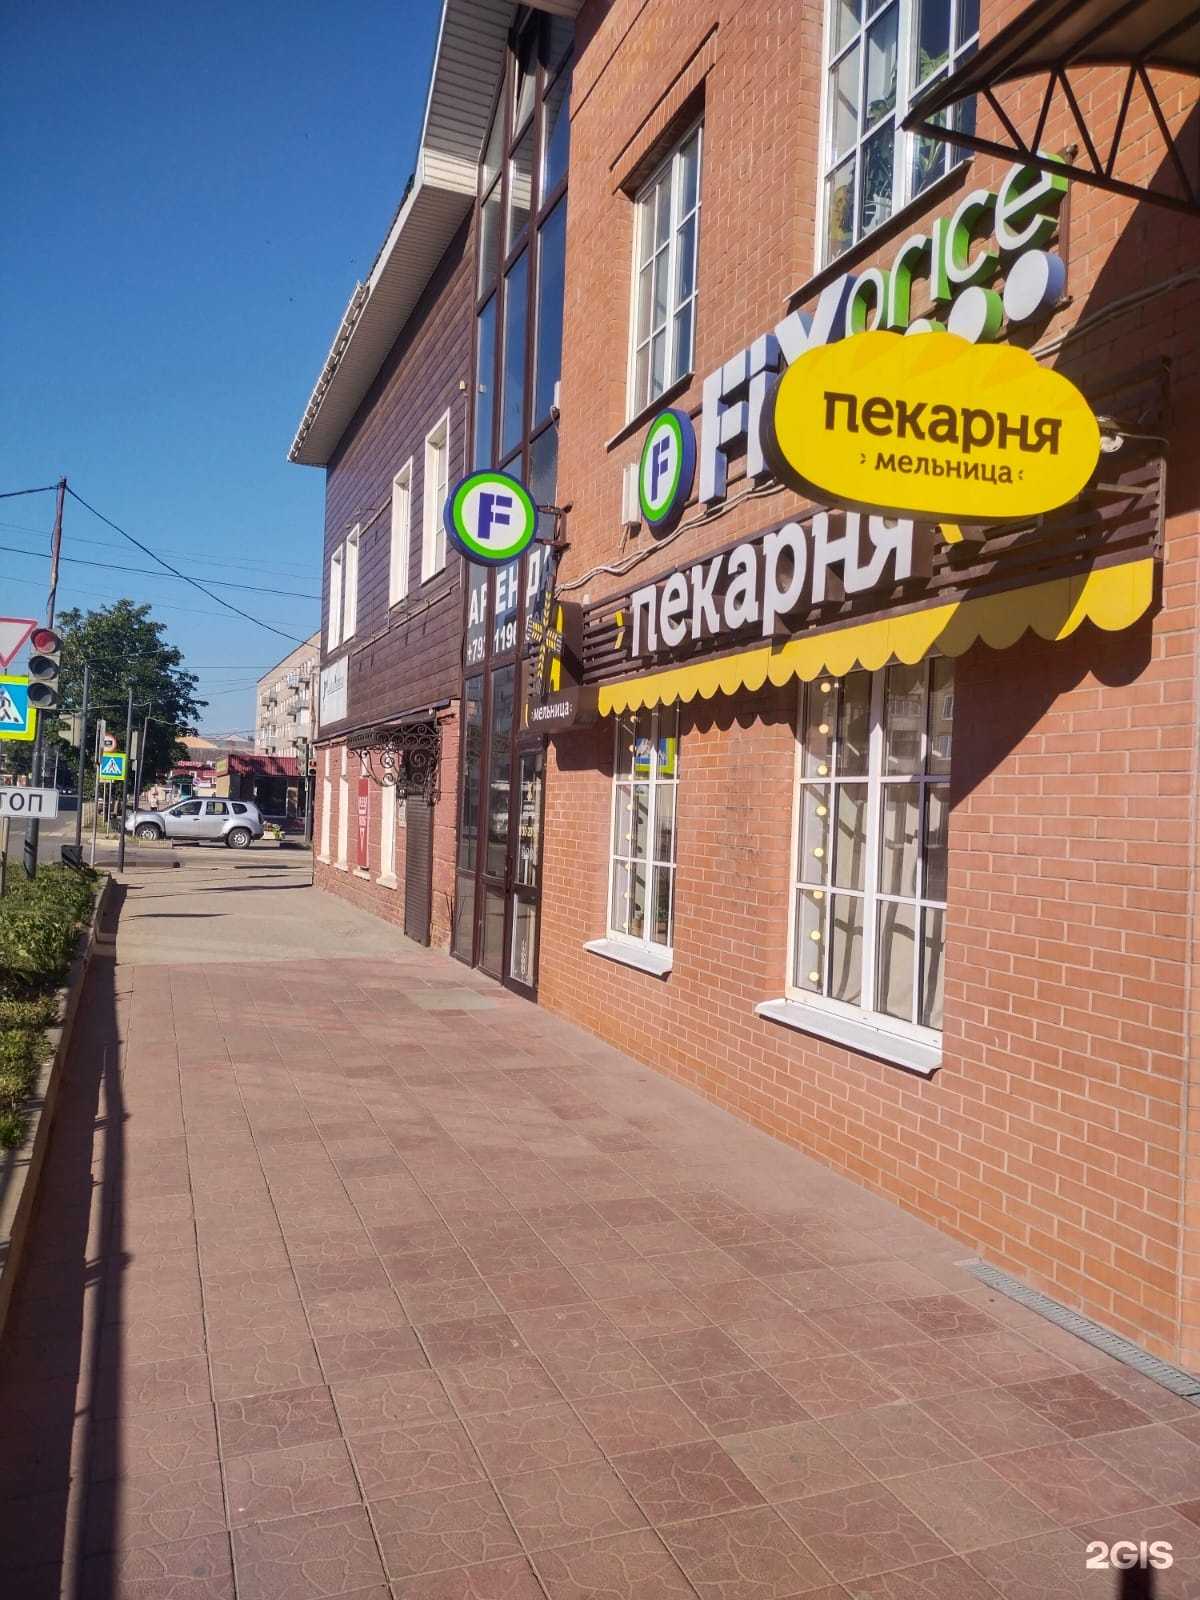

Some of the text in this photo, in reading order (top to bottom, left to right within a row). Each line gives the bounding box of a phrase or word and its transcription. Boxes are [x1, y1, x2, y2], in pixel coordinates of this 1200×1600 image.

[824, 391, 1062, 455] пекарня
[651, 435, 670, 502] F
[875, 452, 1013, 484] мельница
[478, 492, 512, 539] F
[631, 511, 914, 658] пекарня
[533, 701, 569, 721] мельница
